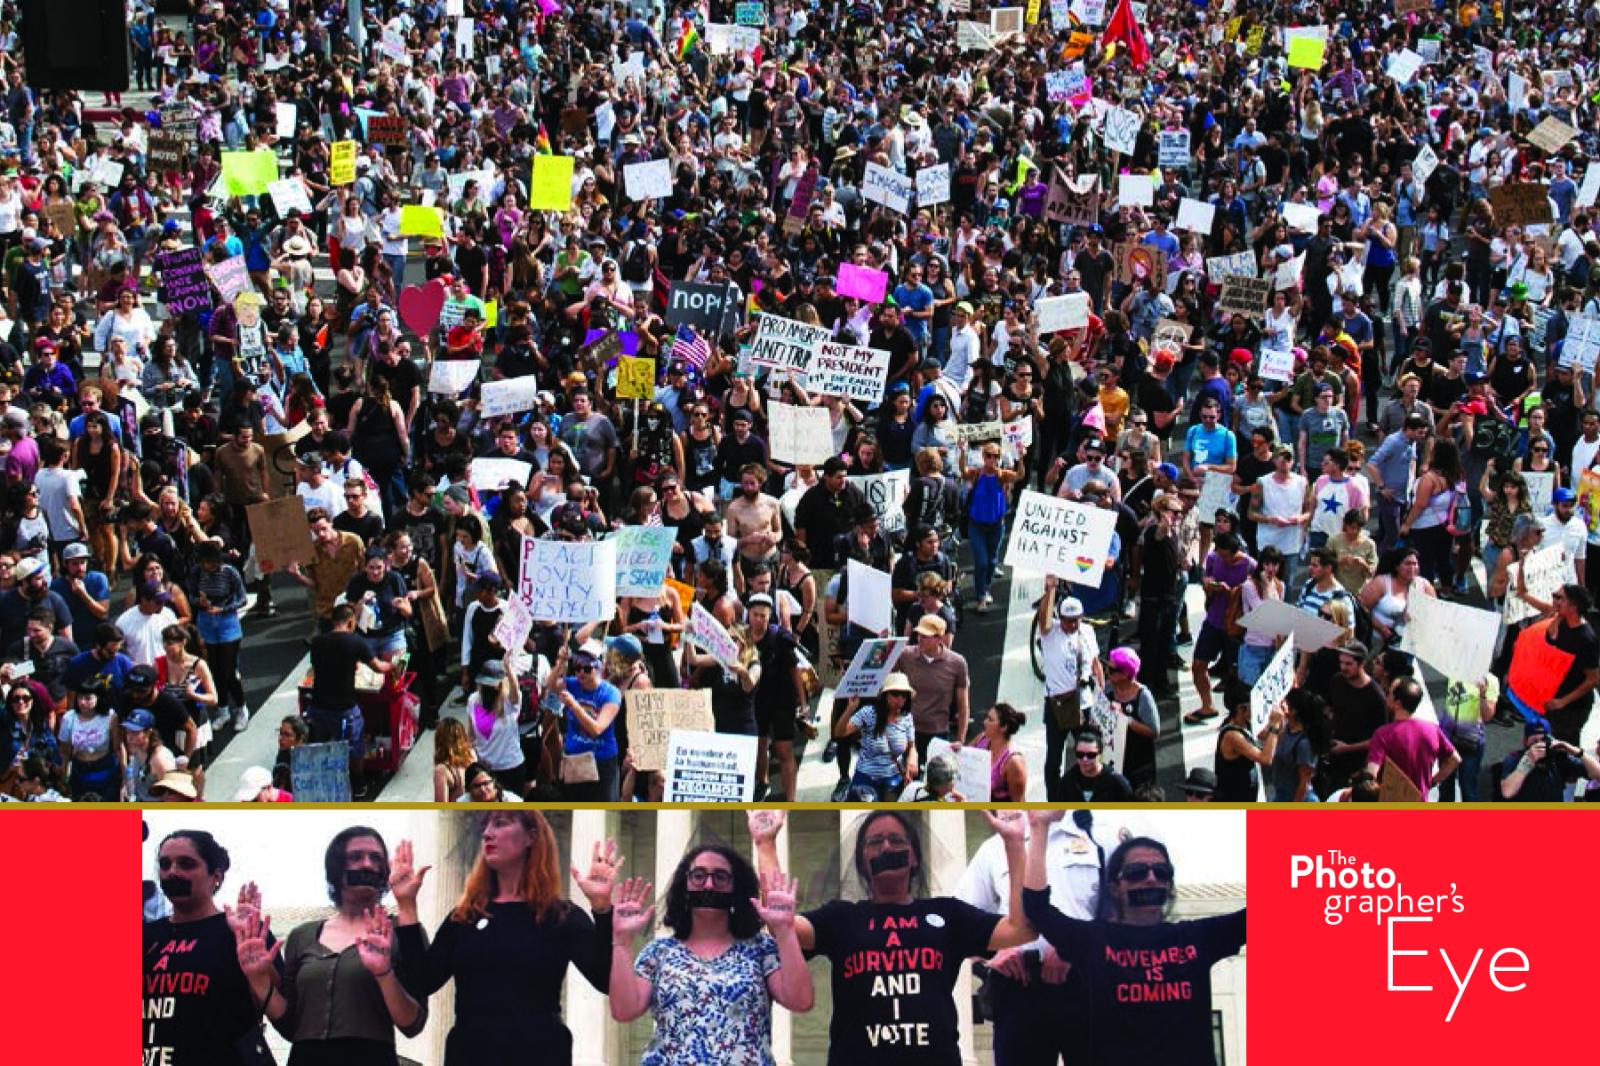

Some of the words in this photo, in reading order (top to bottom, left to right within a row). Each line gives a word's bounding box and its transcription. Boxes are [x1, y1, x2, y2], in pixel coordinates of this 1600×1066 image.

[169, 296, 209, 314] NOW
[762, 316, 785, 337] PRO
[821, 345, 848, 356] NOT
[854, 349, 874, 362] MY
[818, 358, 883, 377] PRESIDENT
[851, 385, 882, 398] FLAT
[1024, 502, 1087, 526] UNITED
[1020, 519, 1088, 545] AGAINST
[1017, 537, 1067, 563] HATE
[882, 916, 919, 929] AM
[160, 939, 198, 954] AM
[886, 932, 902, 947] A
[153, 954, 170, 971] A
[843, 946, 944, 979] SURVIVOR
[1105, 945, 1197, 968] NOVEMBER
[142, 972, 210, 996] VIVOR
[871, 973, 921, 997] AND
[1145, 966, 1165, 982] IS
[1116, 981, 1193, 1003] COMING
[893, 998, 901, 1020] I
[148, 1022, 156, 1044] I
[866, 1023, 930, 1048] VOTE
